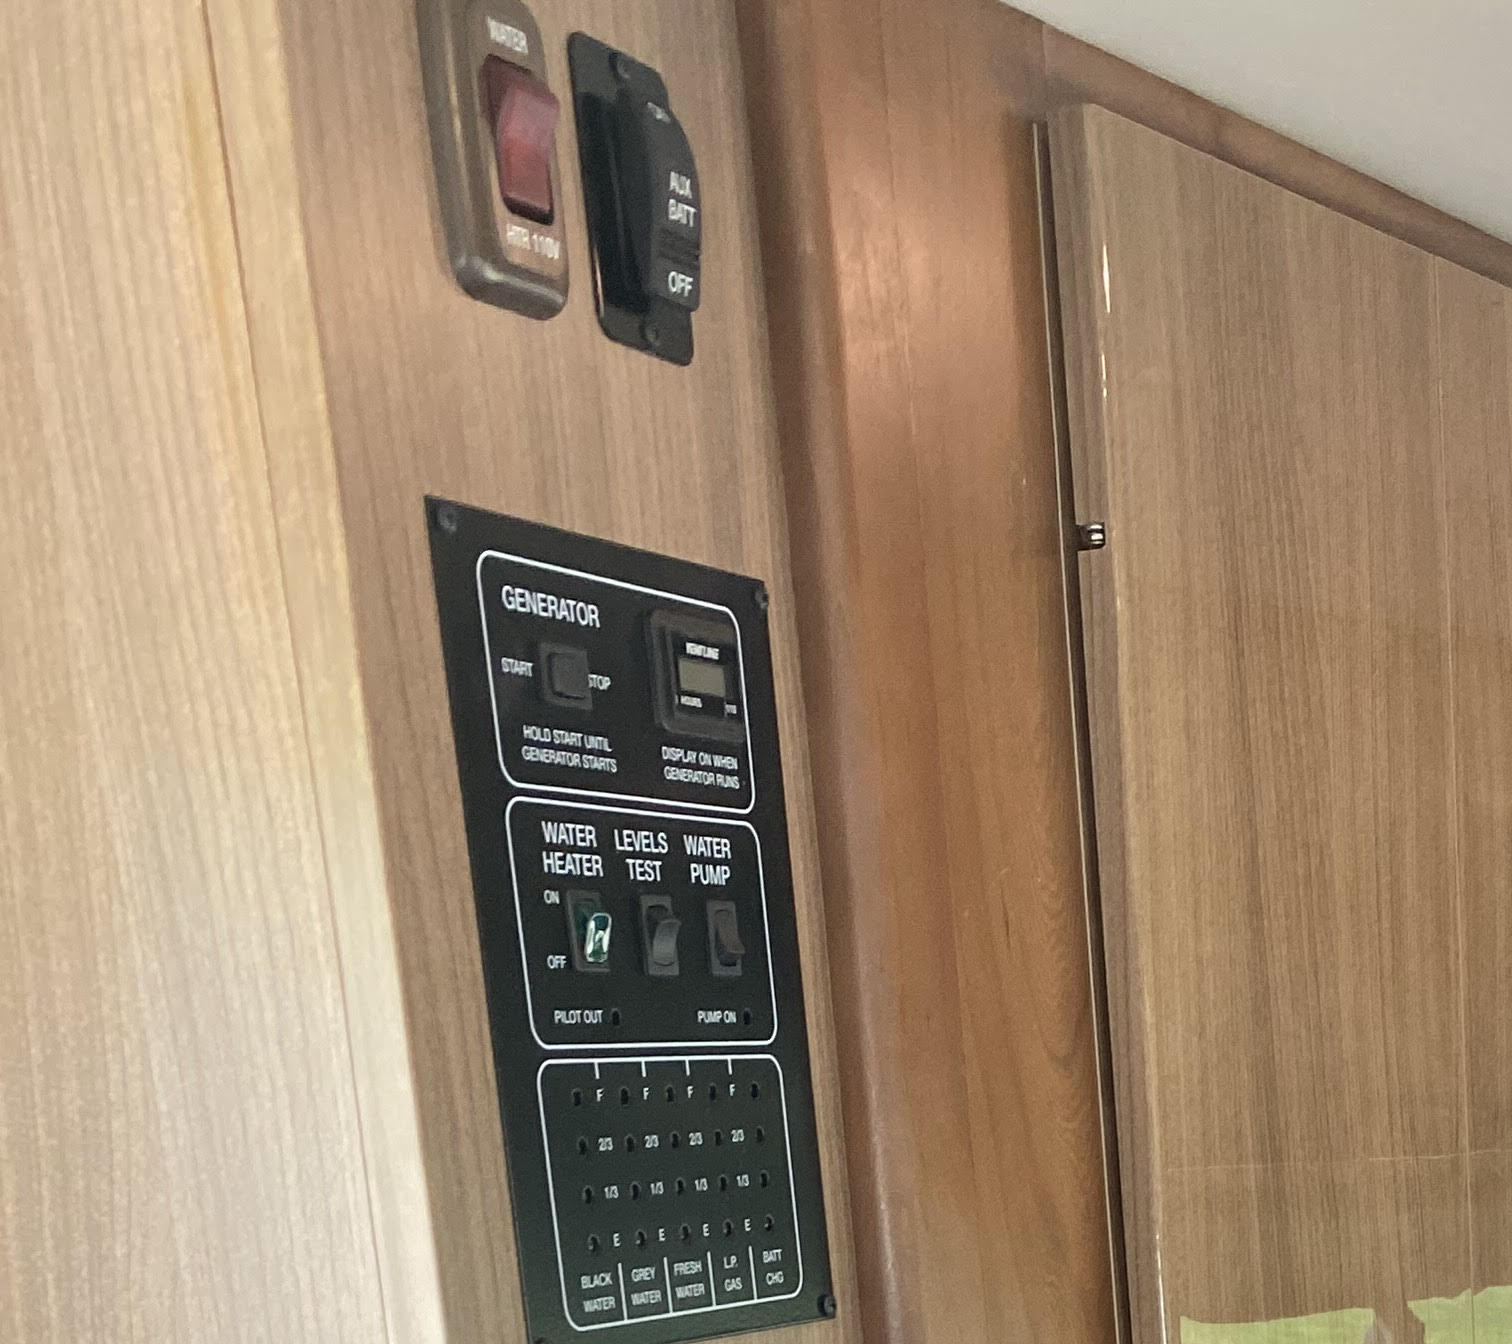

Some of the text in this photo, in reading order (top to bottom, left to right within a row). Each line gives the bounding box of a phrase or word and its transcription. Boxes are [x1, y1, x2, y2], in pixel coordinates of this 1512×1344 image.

[669, 171, 693, 199] AUX
[667, 199, 697, 228] BATT
[667, 271, 694, 298] OFF
[501, 584, 601, 629] GENERATOR
[501, 657, 535, 678] START
[523, 724, 613, 752] HOLD START UNTIL
[521, 745, 618, 773] GENERATOR STARTS
[661, 746, 739, 770] DISPLAY ON WHEN
[663, 765, 741, 790] GENERATOR RUNS
[541, 820, 598, 848] WATER
[613, 828, 669, 854] LEVELS
[682, 834, 732, 860] WATER
[542, 851, 604, 878] HEATER
[625, 858, 663, 882] TEST
[690, 863, 731, 886] PUMP
[543, 889, 561, 904] ON
[546, 955, 568, 969] OFF
[553, 1009, 604, 1025] PILOT OUT
[697, 1010, 737, 1024] PUMP ON
[596, 1083, 736, 1102] F F F F
[598, 1129, 745, 1151] 2/3 2/3 2/3 2/3
[604, 1174, 750, 1200] 1/3 1/3 1/3 1/3
[612, 1218, 752, 1247] E E E E
[762, 1248, 783, 1263] BATT
[631, 1266, 656, 1282] GREY
[673, 1260, 703, 1276] FRESH
[766, 1270, 784, 1285] CHG
[580, 1272, 613, 1289] BLACK
[675, 1283, 705, 1299] WATER
[724, 1276, 743, 1292] GAS
[583, 1296, 616, 1312] WATER
[631, 1290, 662, 1306] WATER
